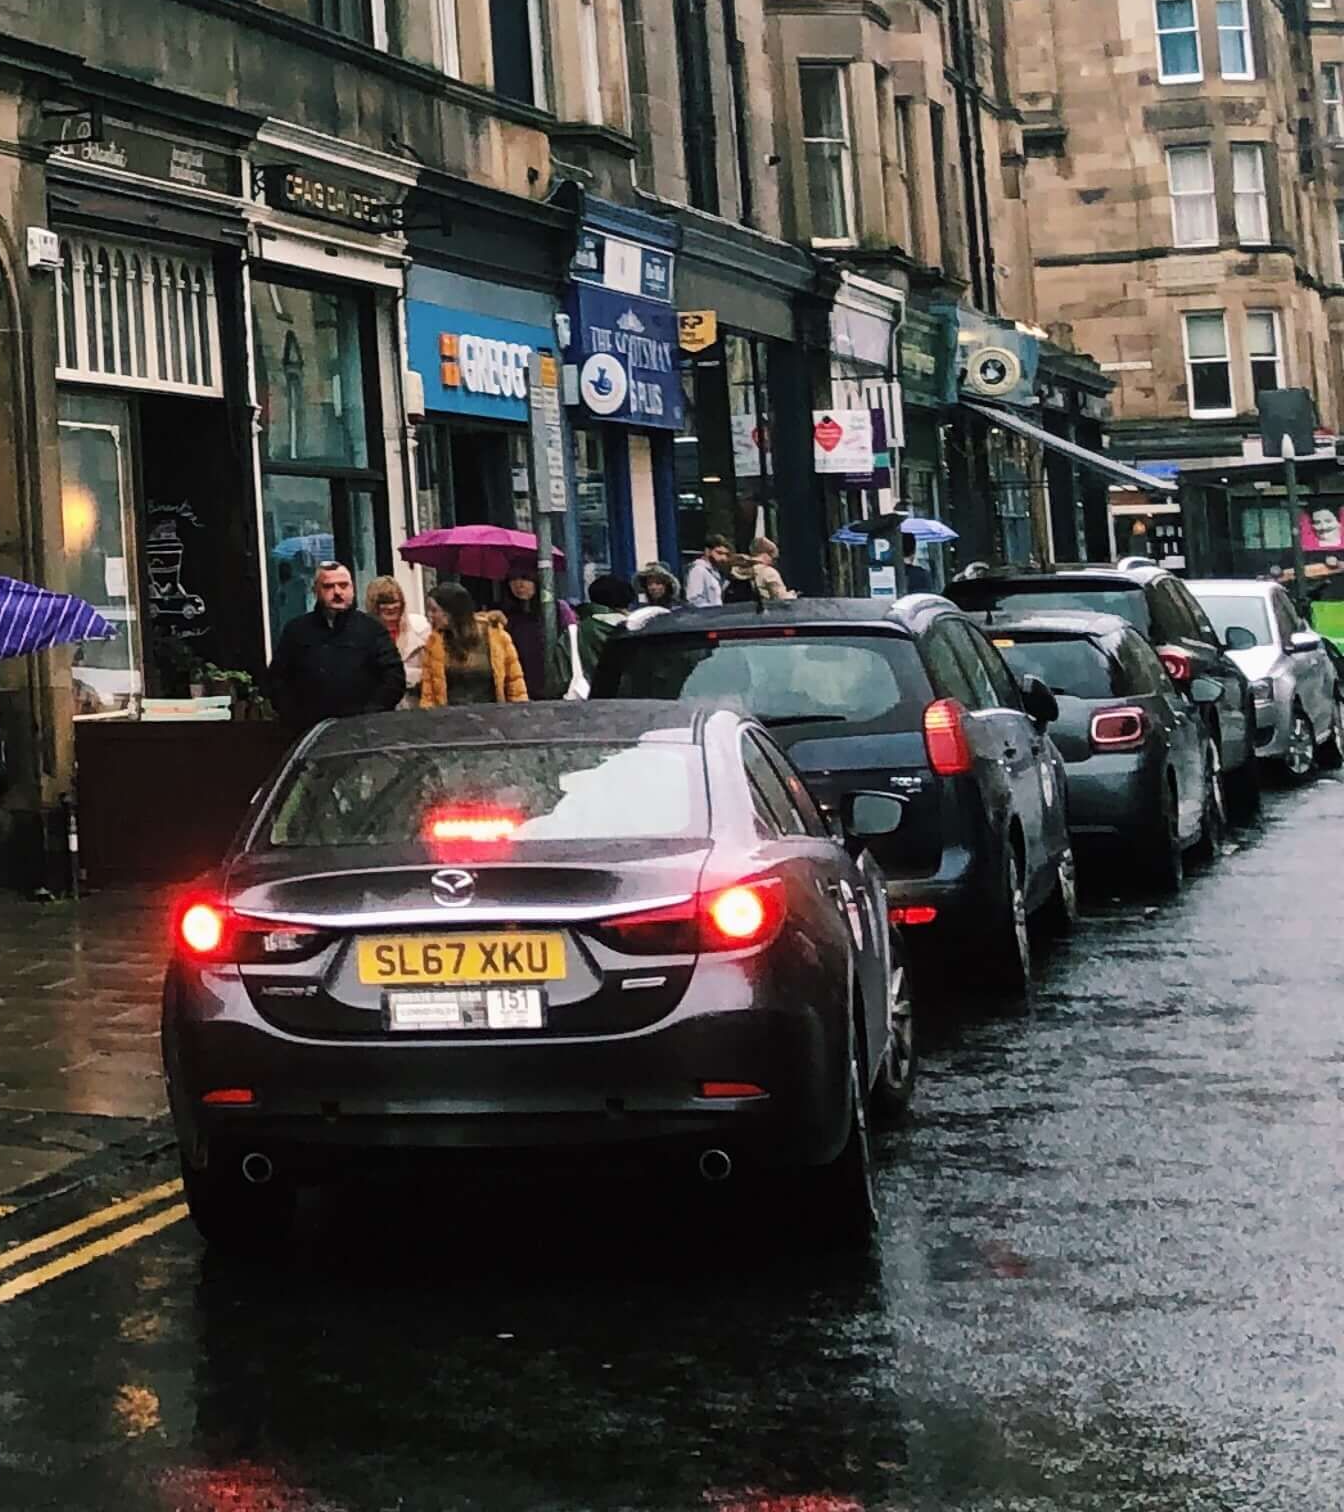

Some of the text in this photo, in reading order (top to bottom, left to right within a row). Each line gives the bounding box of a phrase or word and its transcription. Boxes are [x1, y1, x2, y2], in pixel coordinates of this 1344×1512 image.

[459, 334, 532, 399] GREGG
[874, 538, 891, 561] P
[375, 940, 549, 976] SL67 XKU
